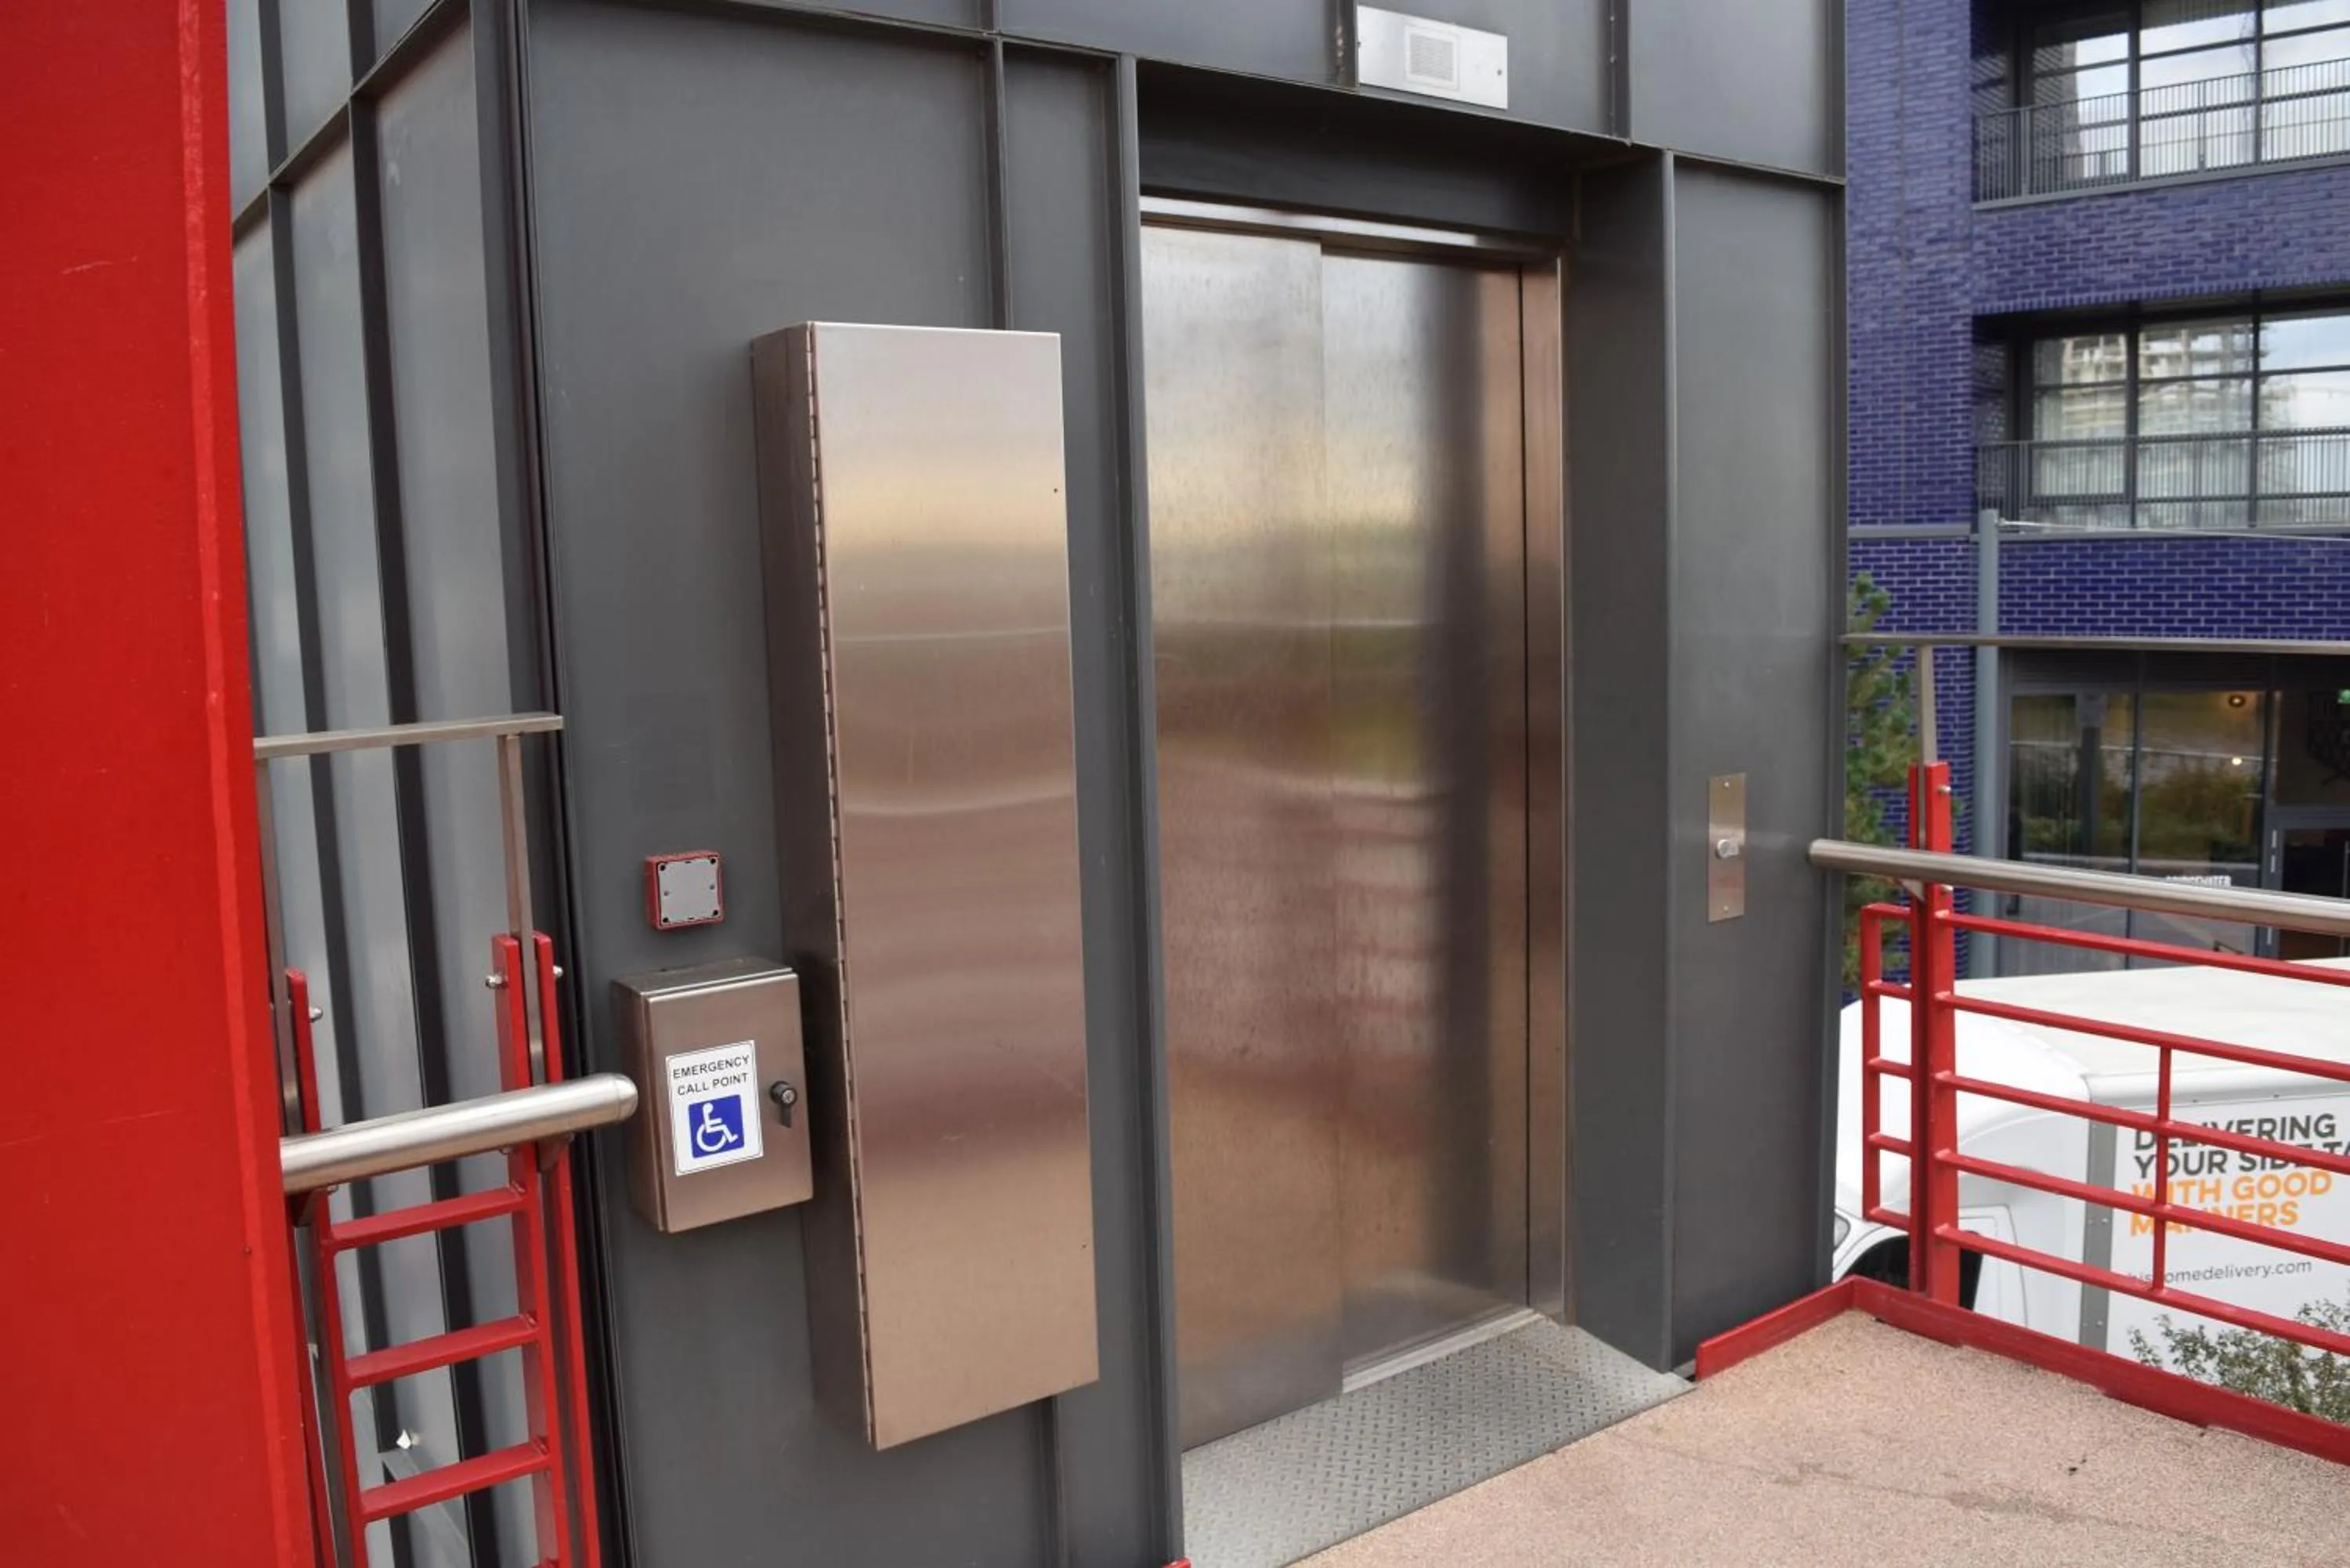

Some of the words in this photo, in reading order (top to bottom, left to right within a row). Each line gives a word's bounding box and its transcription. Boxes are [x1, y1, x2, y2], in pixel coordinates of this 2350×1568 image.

[673, 1054, 750, 1079] EMERGENCY
[678, 1082, 709, 1096] CALL
[713, 1072, 749, 1088] POINT
[2135, 1113, 2336, 1150] DERING
[2135, 1150, 2228, 1179] YOUR
[2238, 1143, 2312, 1172] SID
[2232, 1171, 2332, 1201] GOOD
[2130, 1201, 2299, 1237] MAERS
